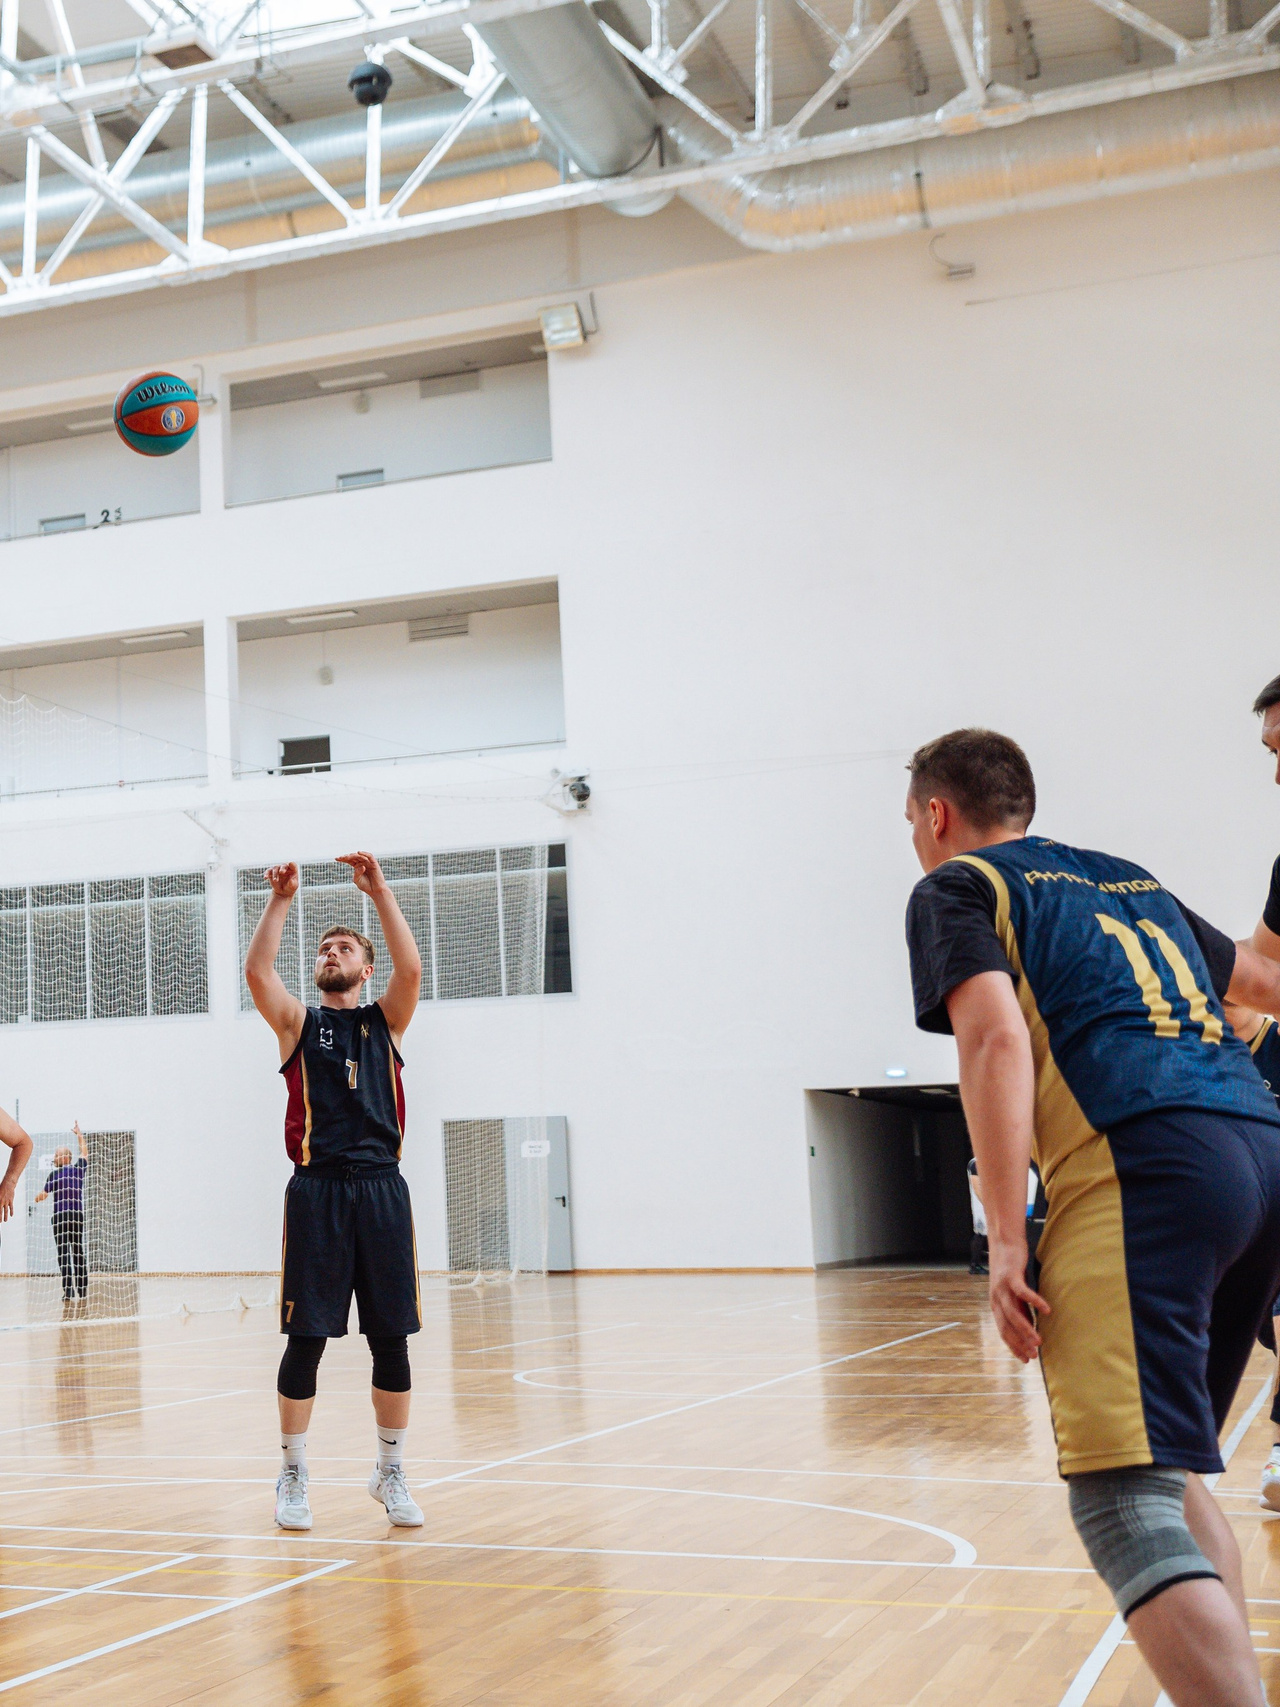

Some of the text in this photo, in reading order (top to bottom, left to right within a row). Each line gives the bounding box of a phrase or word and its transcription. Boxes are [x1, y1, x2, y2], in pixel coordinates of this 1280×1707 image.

[135, 382, 190, 402] Wilson
[1094, 913, 1223, 1045] 11
[285, 1300, 295, 1323] 7
